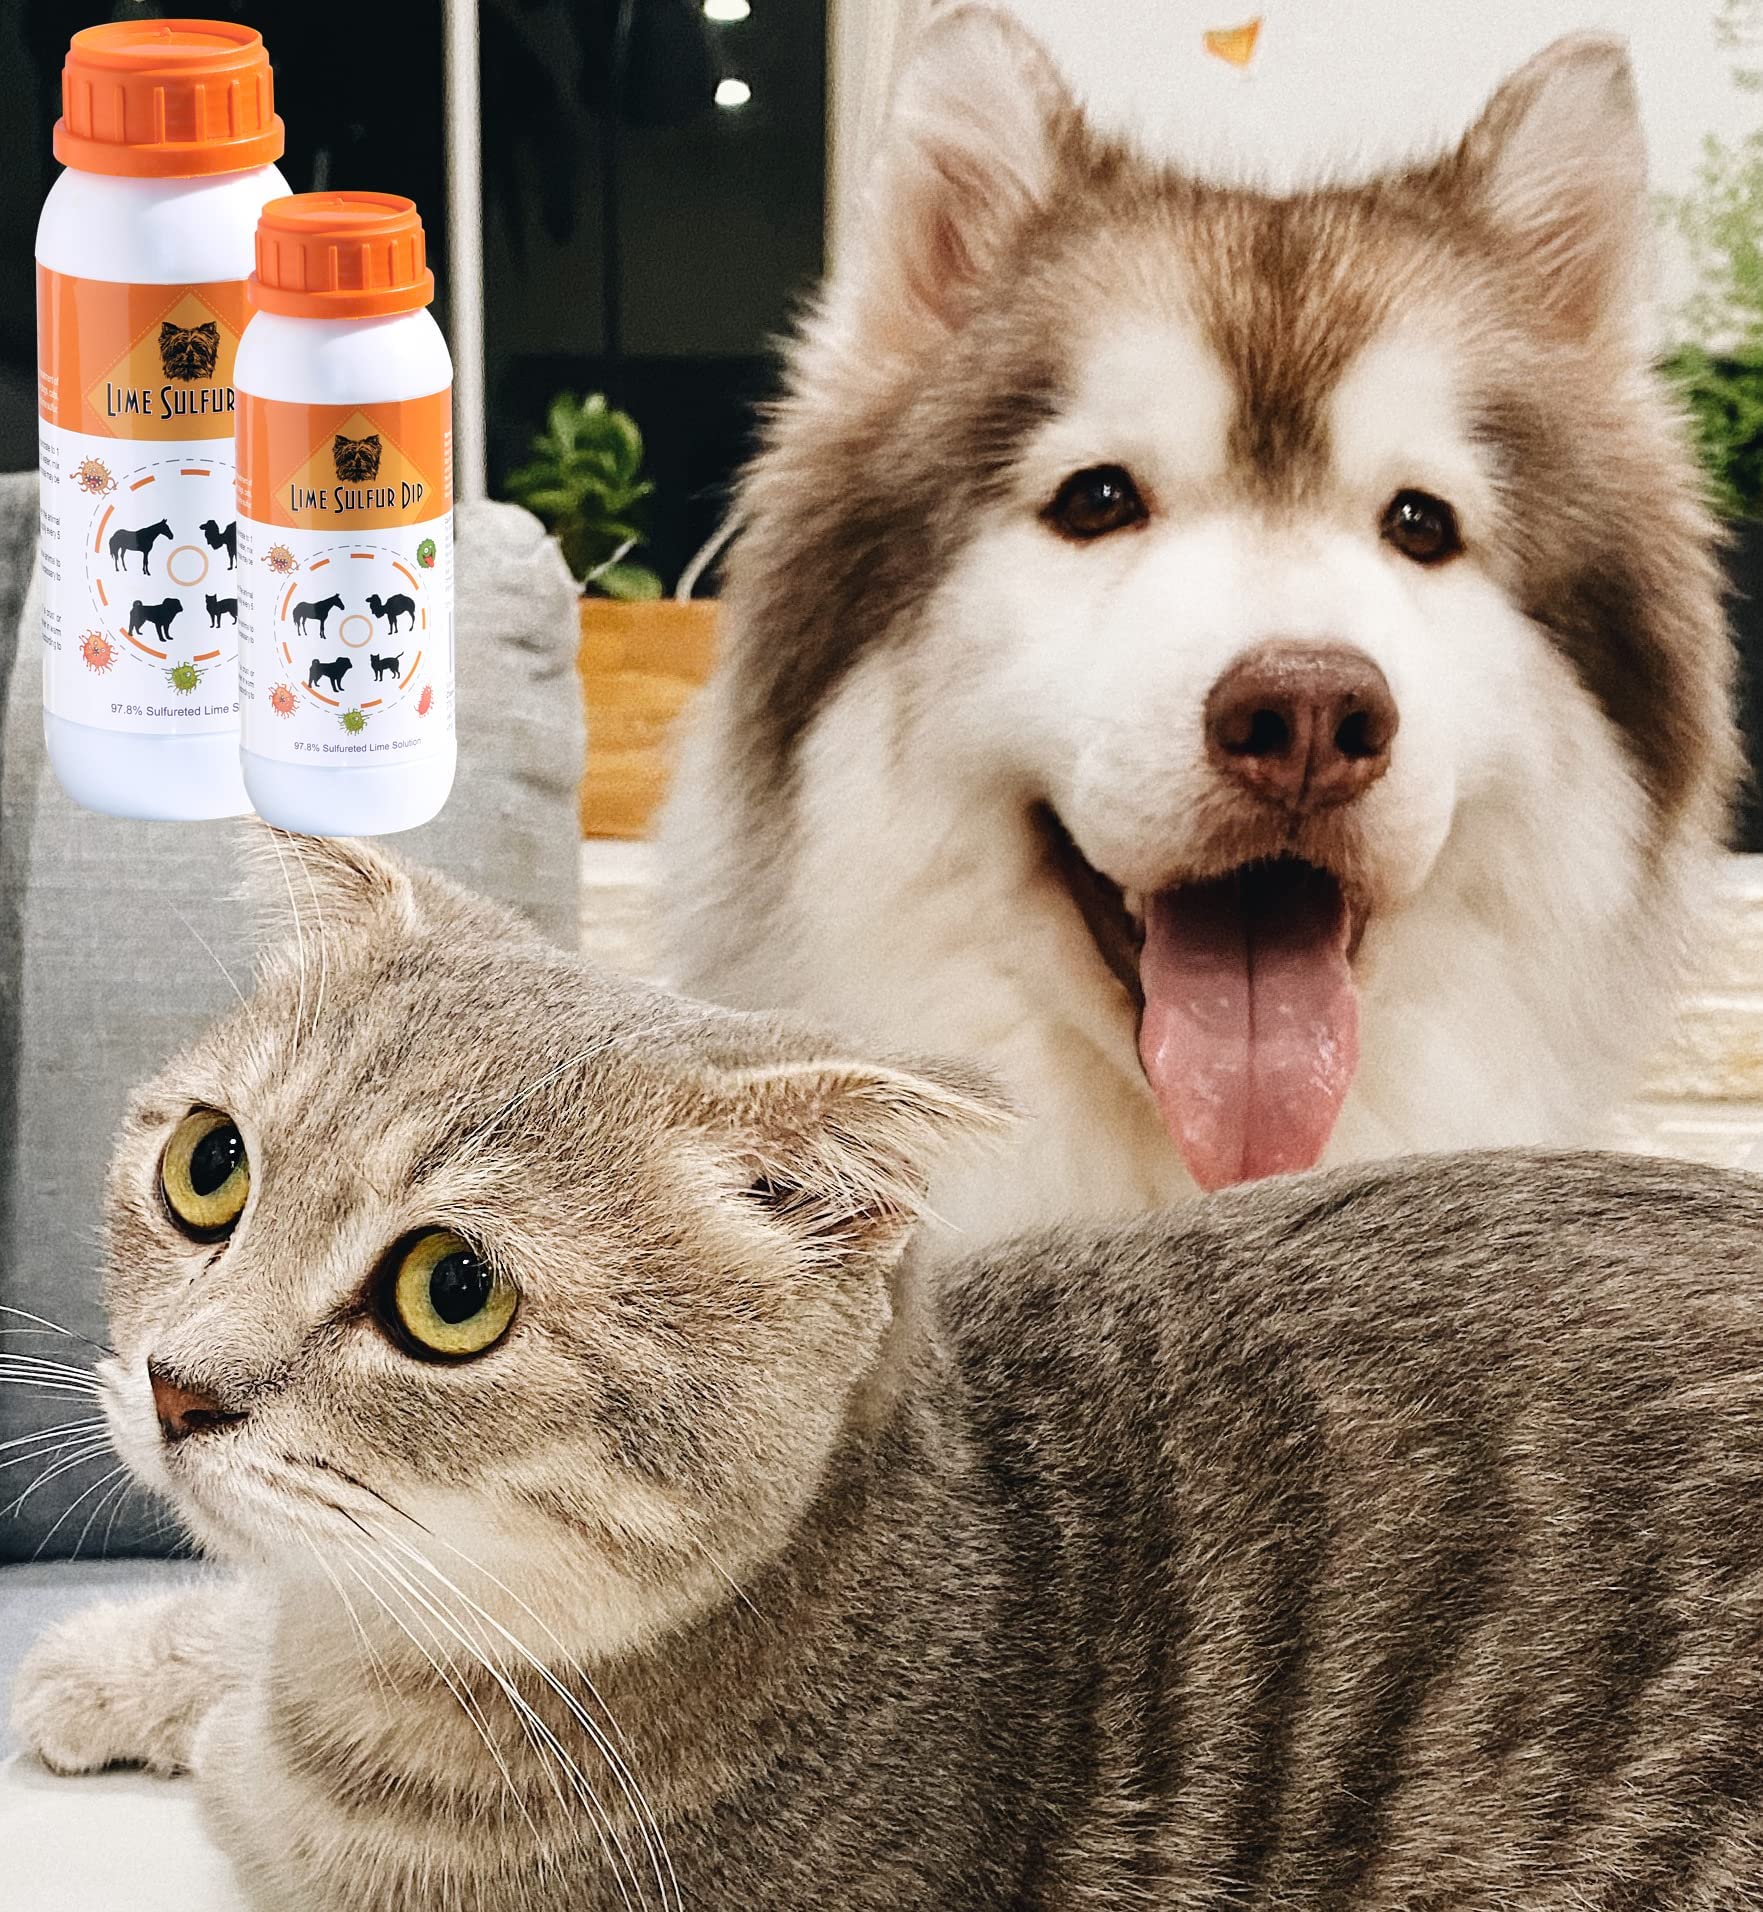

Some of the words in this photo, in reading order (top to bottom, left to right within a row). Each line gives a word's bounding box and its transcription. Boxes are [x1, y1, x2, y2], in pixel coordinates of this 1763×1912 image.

[107, 382, 152, 417] LIME
[160, 385, 235, 420] SULFUR
[291, 483, 328, 512] LIME
[334, 486, 395, 514] SULFUR
[401, 481, 424, 510] DIP
[110, 703, 143, 716] 97.8%
[146, 706, 201, 717] Sulfureted
[204, 704, 229, 716] Lime
[294, 741, 320, 752] 97.8%
[322, 744, 367, 753] Sulfureted
[369, 743, 390, 752] Lime
[392, 737, 422, 750] Solution
